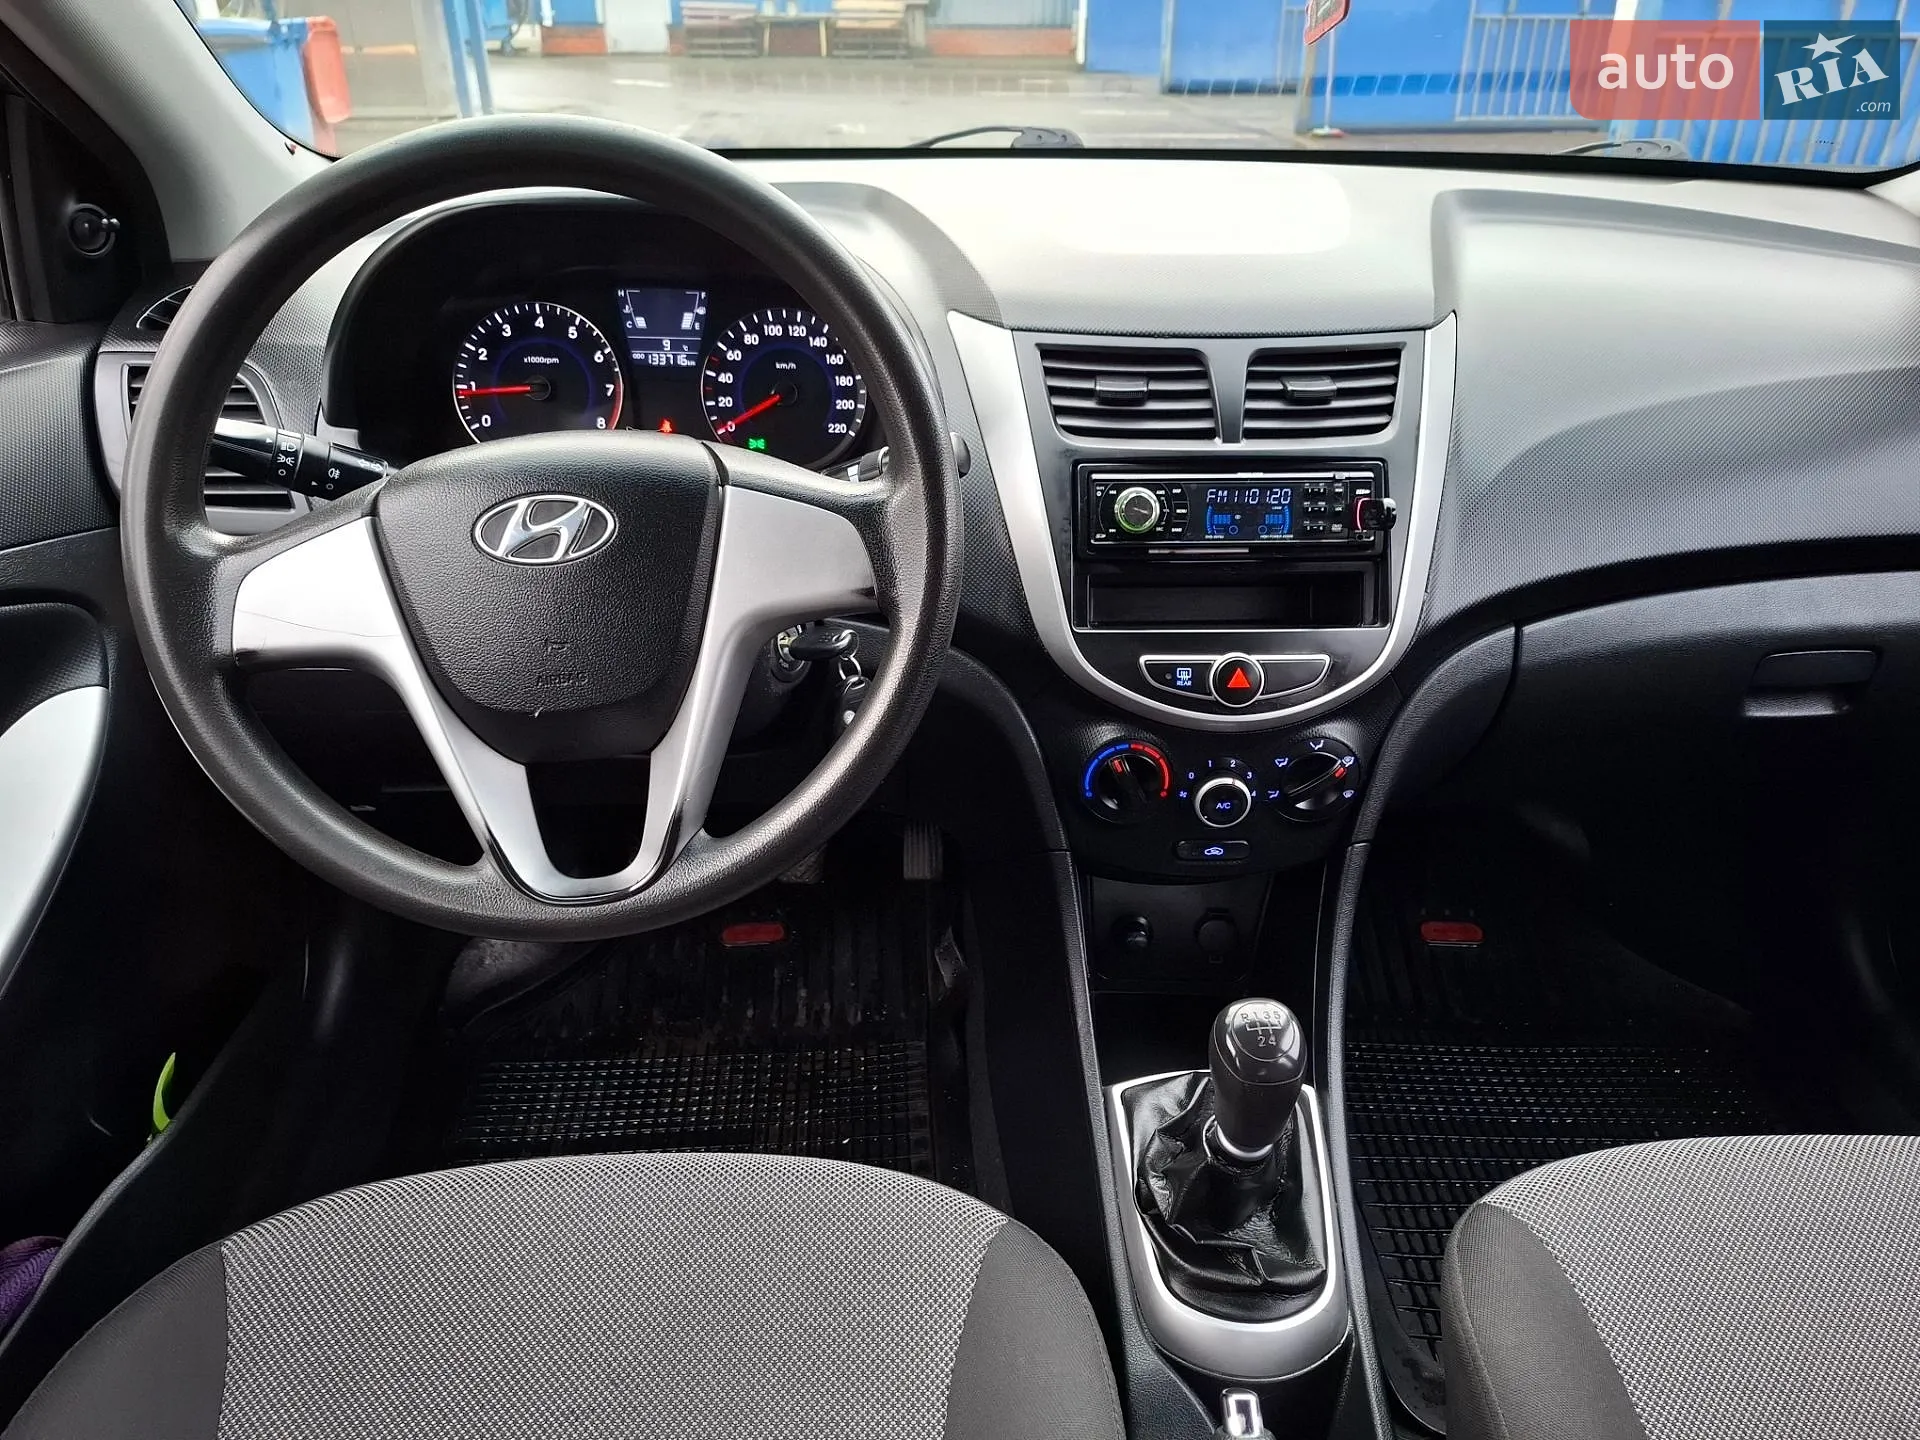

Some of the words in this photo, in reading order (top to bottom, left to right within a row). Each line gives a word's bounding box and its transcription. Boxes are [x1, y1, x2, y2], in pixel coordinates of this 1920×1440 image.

[617, 289, 625, 297] H
[701, 291, 707, 300] F
[534, 315, 545, 329] 4
[502, 324, 512, 337] 3
[567, 326, 578, 339] 5
[763, 324, 783, 337] 100
[788, 324, 807, 337] 120
[662, 339, 671, 351] 9
[744, 333, 759, 345] 80
[809, 336, 828, 348] 140
[478, 348, 488, 361] 2
[593, 350, 604, 363] 6
[726, 350, 742, 361] 60
[825, 353, 844, 365] 160
[775, 362, 797, 371] km/h
[718, 372, 733, 384] 40
[835, 375, 854, 387] 180
[605, 384, 615, 396] 7
[718, 397, 733, 408] 20
[836, 399, 855, 410] 200
[481, 414, 492, 427] 0
[596, 417, 607, 429] 8
[727, 420, 736, 433] 0
[828, 423, 847, 434] 220
[1263, 1011, 1271, 1019] 3
[1258, 1036, 1266, 1047] 2
[1269, 1034, 1276, 1046] 4
